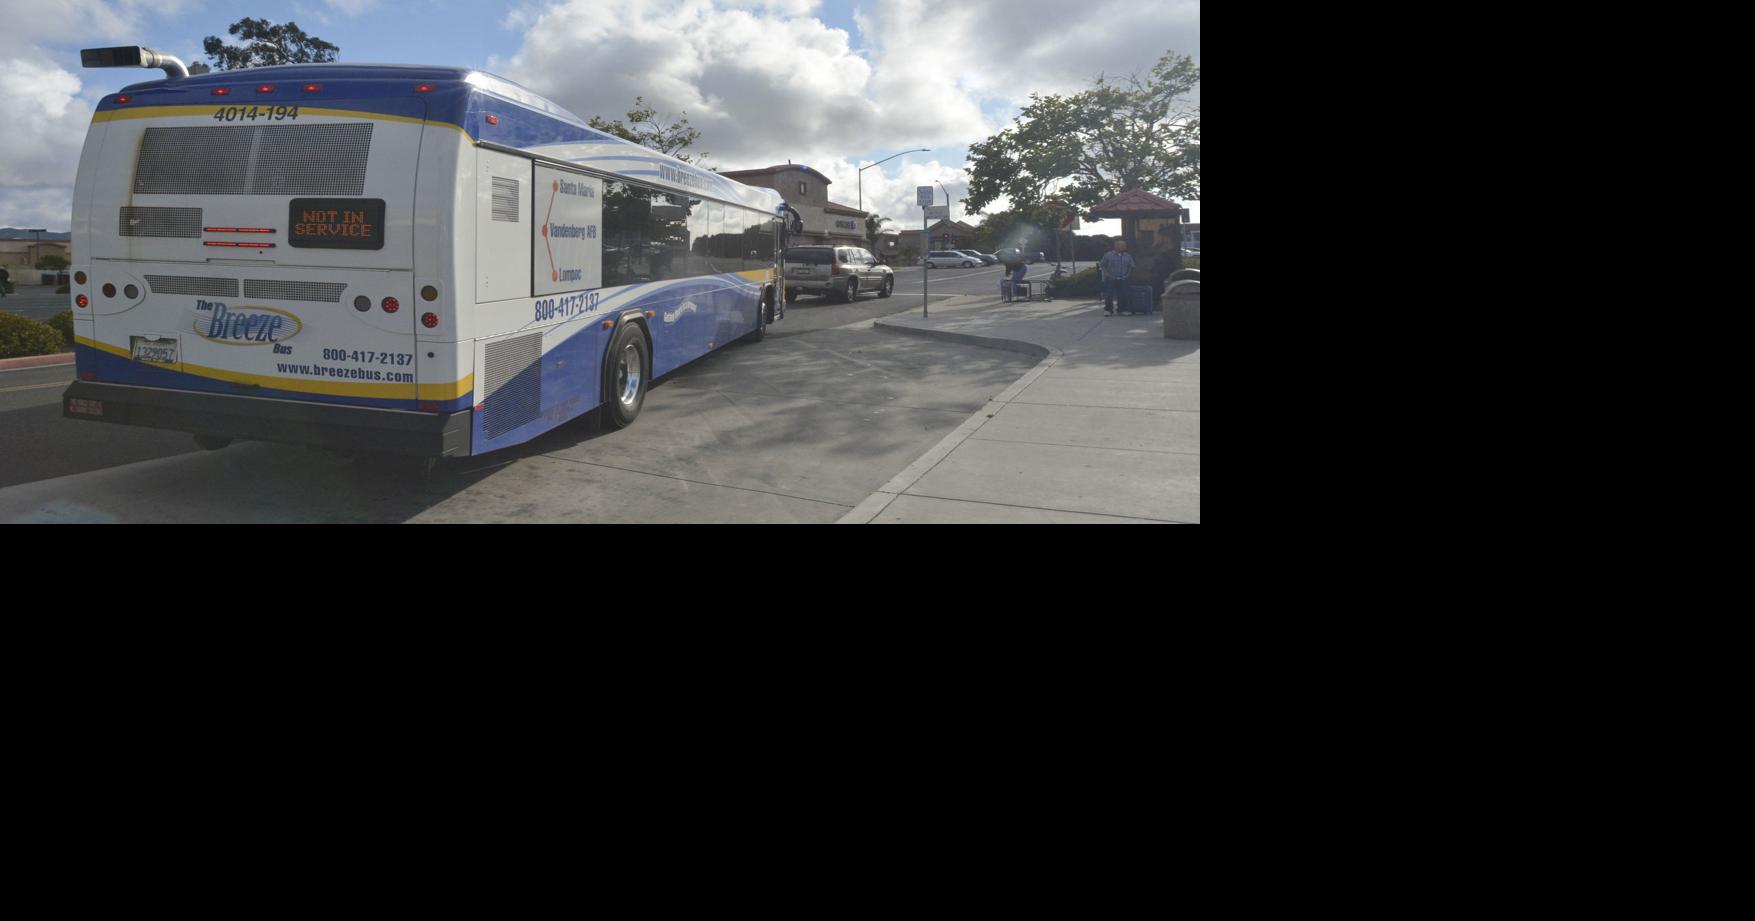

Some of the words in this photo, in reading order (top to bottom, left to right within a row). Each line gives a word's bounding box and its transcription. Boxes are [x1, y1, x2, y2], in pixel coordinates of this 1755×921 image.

[213, 105, 300, 122] 4014-194
[559, 179, 577, 196] Santa
[578, 182, 595, 199] Maria
[303, 210, 338, 224] NOT
[343, 211, 365, 223] IN
[295, 224, 372, 237] SERVICE
[550, 223, 585, 240] Vandenberg
[586, 225, 597, 239] AFB
[559, 267, 582, 283] Lompoc
[196, 300, 213, 311] The
[535, 293, 600, 322] 800-417-2137
[207, 302, 282, 342] Breeze
[273, 343, 292, 355] Bus
[323, 348, 413, 366] 800-417-2137
[277, 362, 414, 383] www.breezebus.com
